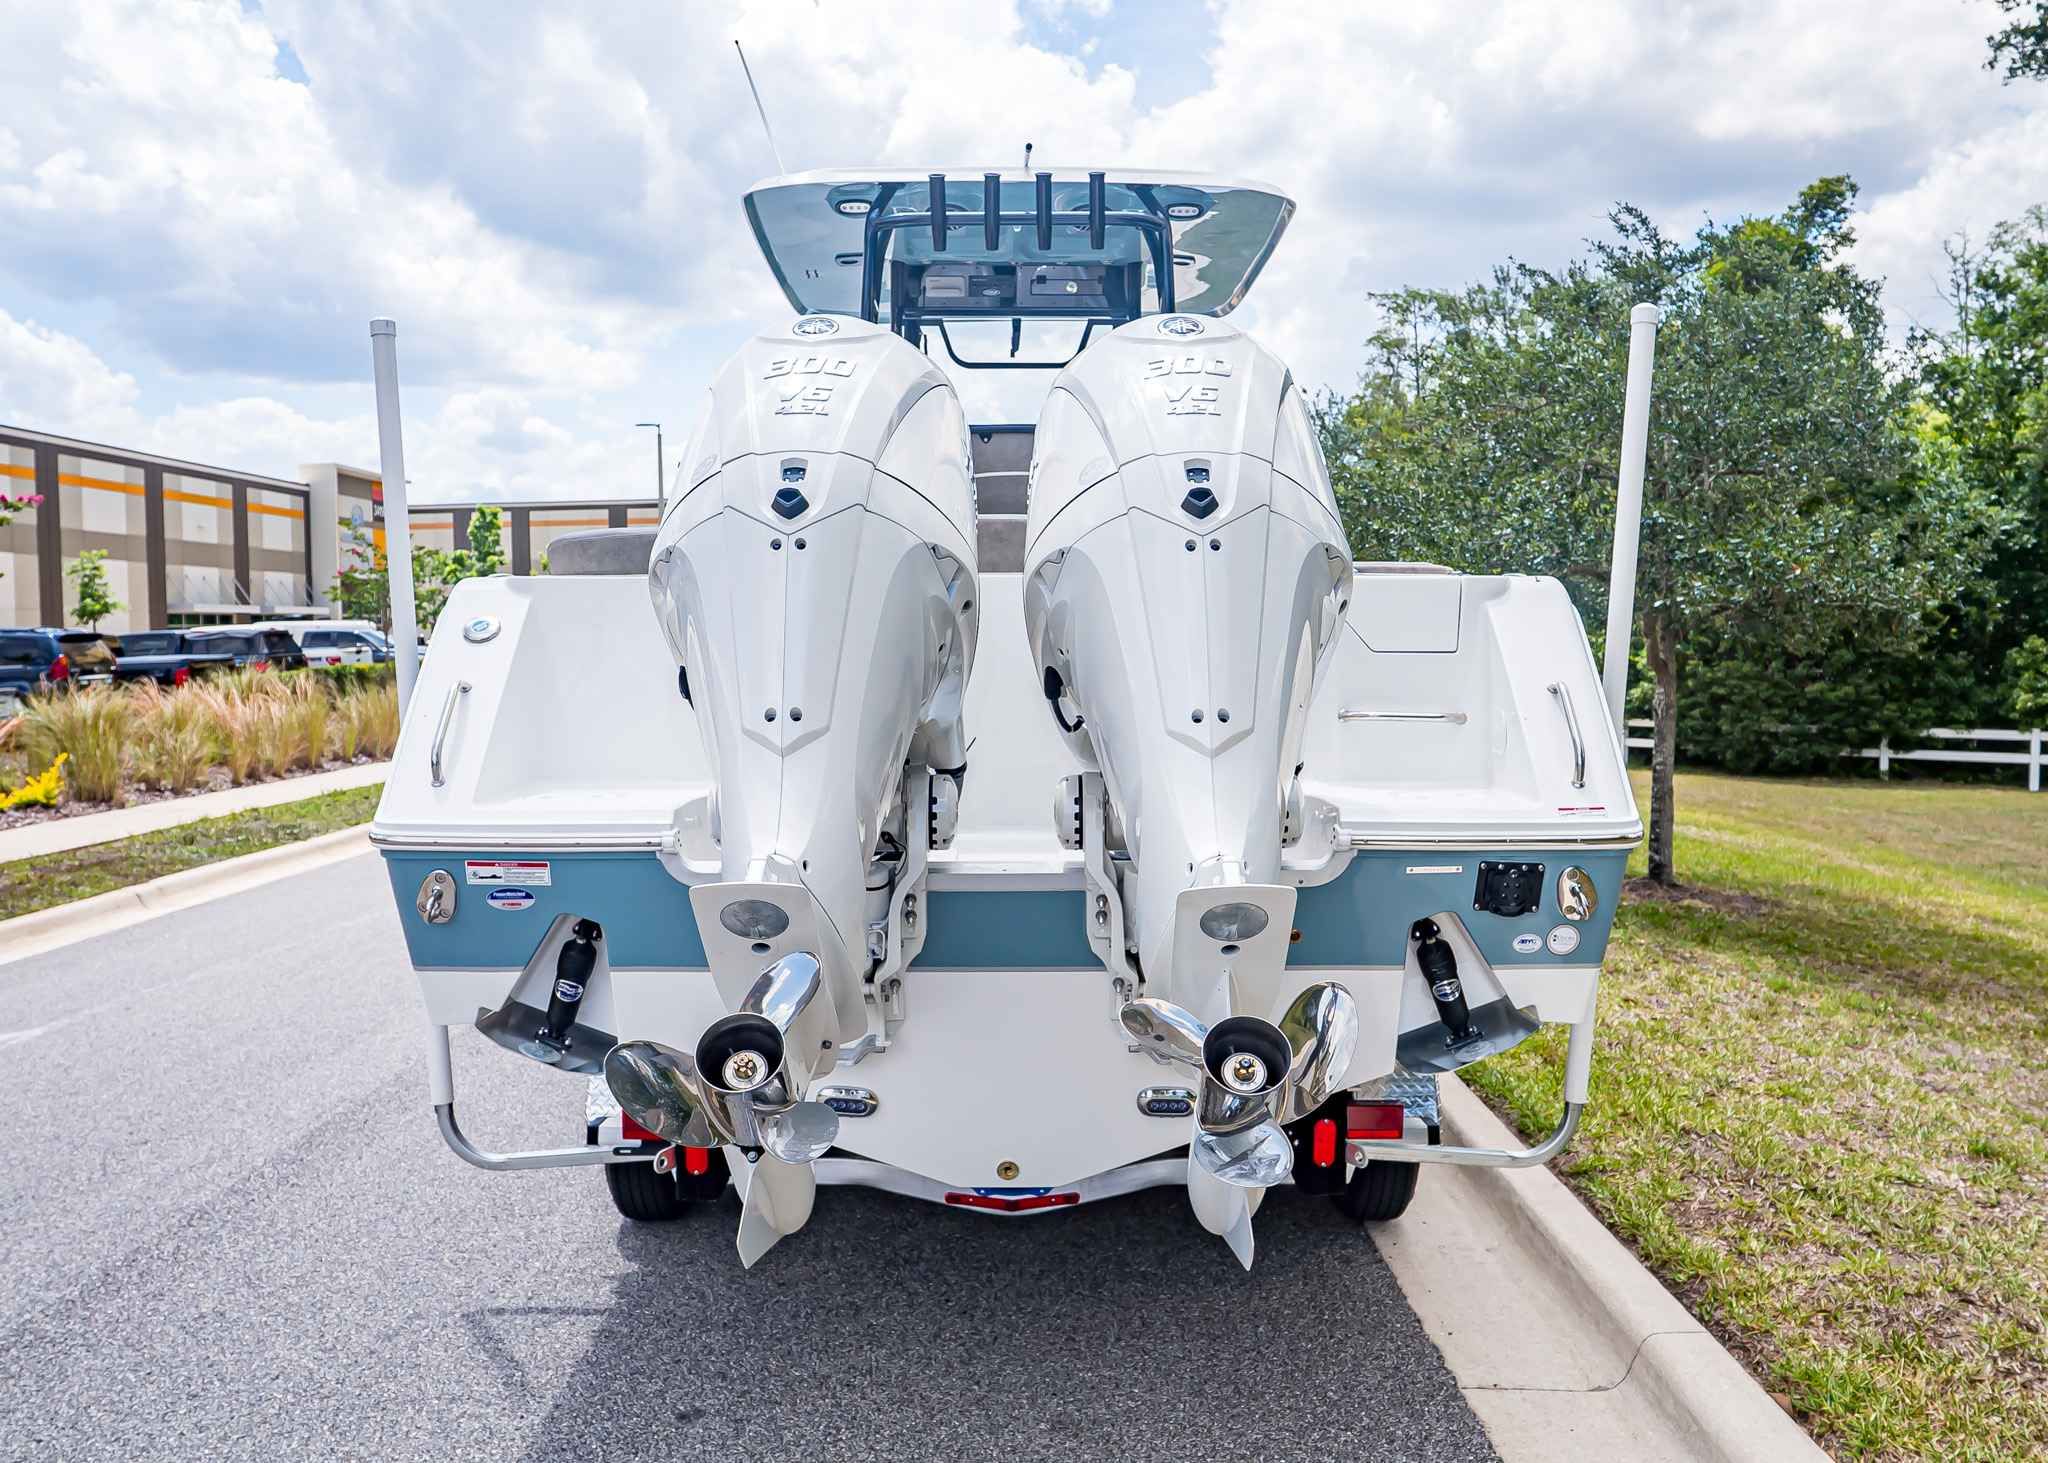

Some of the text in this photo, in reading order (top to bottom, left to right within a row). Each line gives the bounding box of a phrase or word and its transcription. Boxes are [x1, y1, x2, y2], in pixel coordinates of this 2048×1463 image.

[763, 355, 857, 380] 300
[1143, 355, 1232, 380] 300
[777, 384, 833, 402] V6
[1162, 384, 1219, 402] V6
